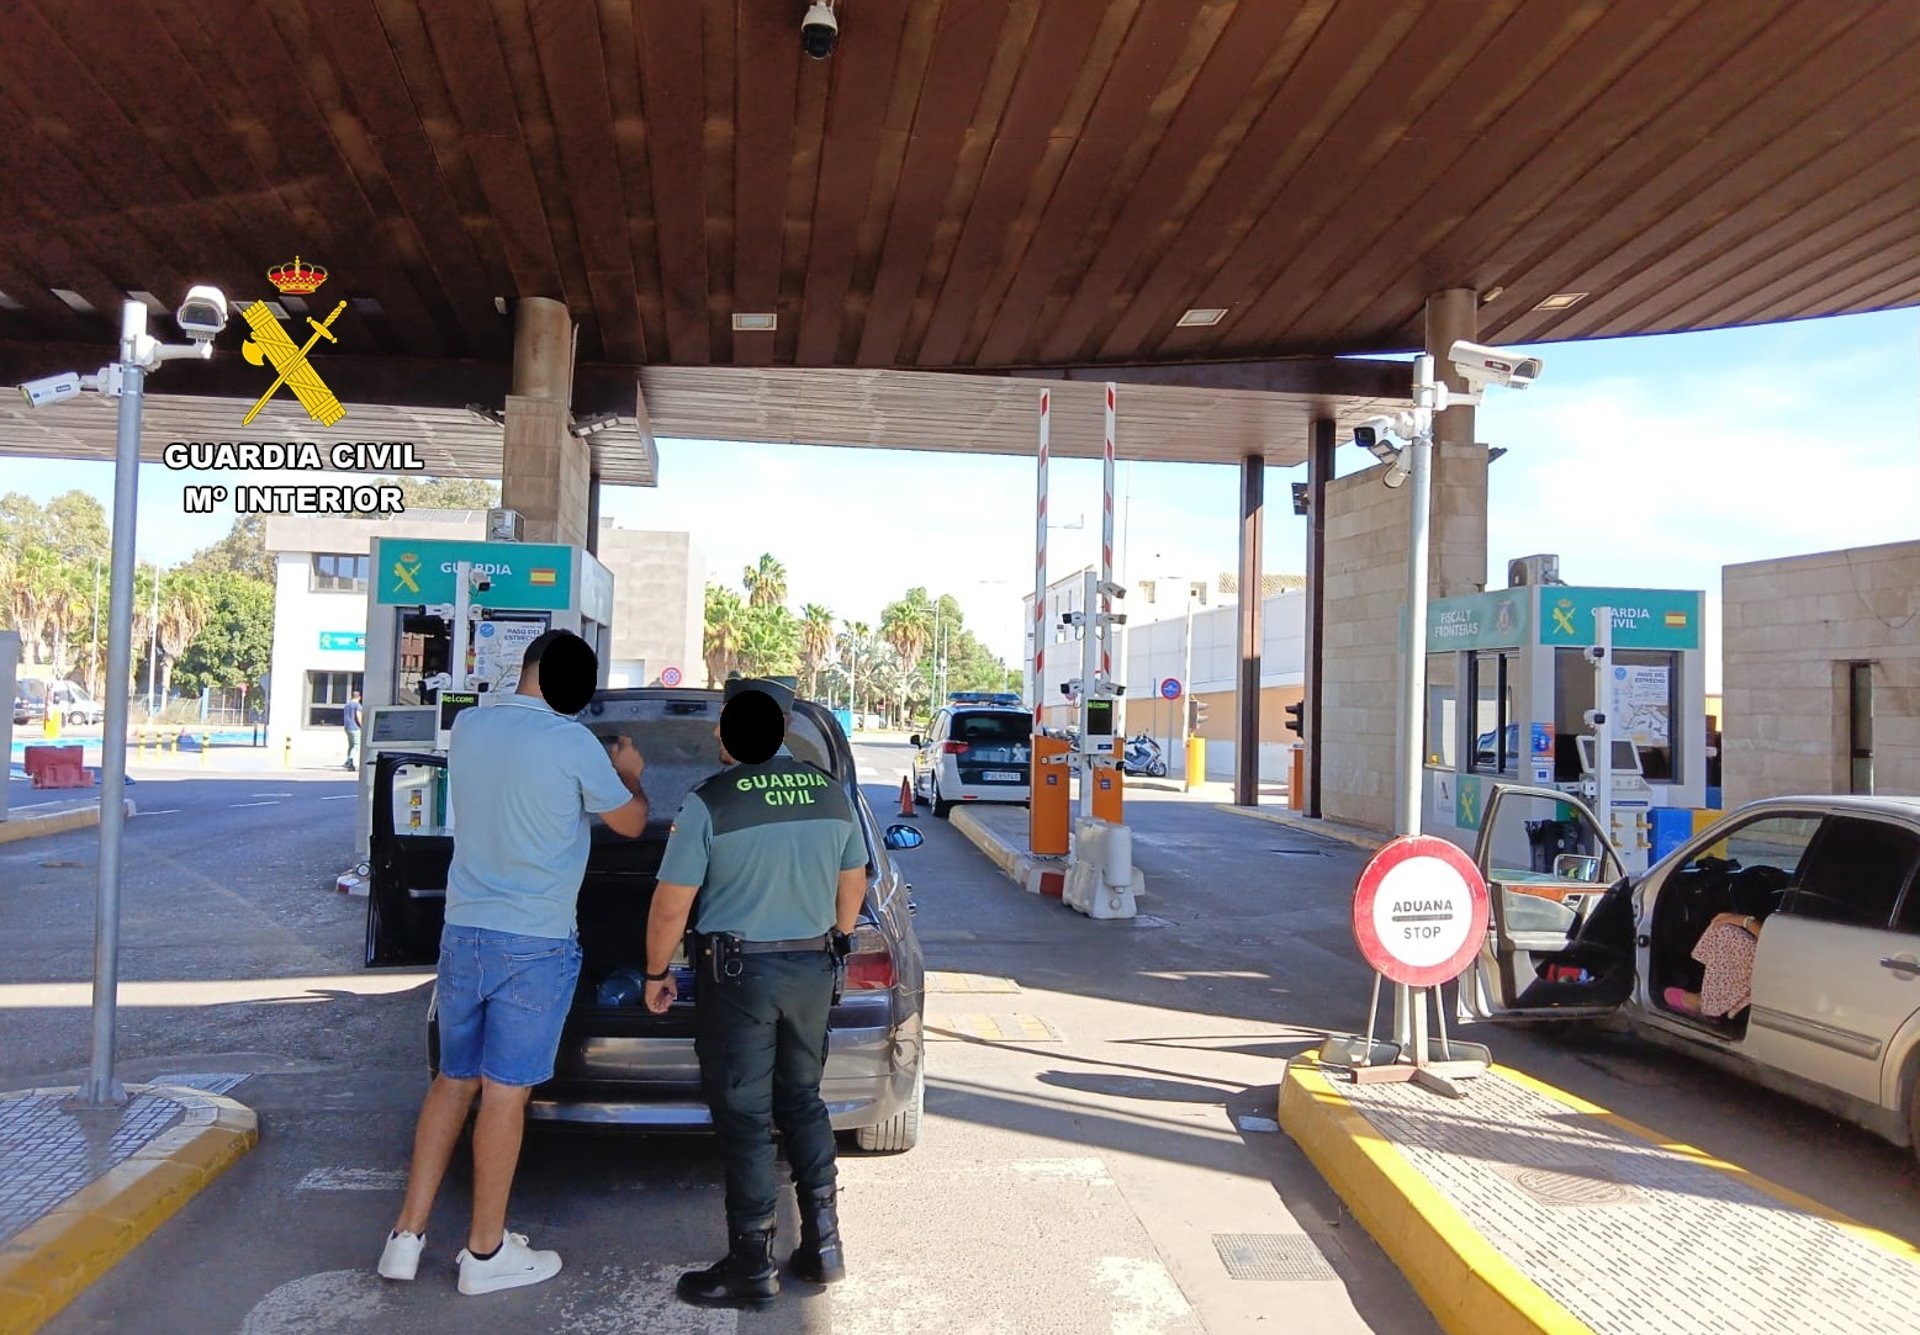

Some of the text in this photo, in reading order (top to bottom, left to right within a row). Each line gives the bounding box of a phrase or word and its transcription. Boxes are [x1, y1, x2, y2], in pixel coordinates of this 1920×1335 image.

[440, 562, 512, 575] GURDIA
[1591, 607, 1650, 619] GARDIA
[1435, 623, 1478, 637] FRONTERAS
[1611, 618, 1637, 629] IVIL
[737, 774, 828, 791] GUARDIA
[765, 790, 815, 806] CIVIL
[1393, 900, 1453, 913] ADUANA
[1404, 926, 1441, 939] STOP
